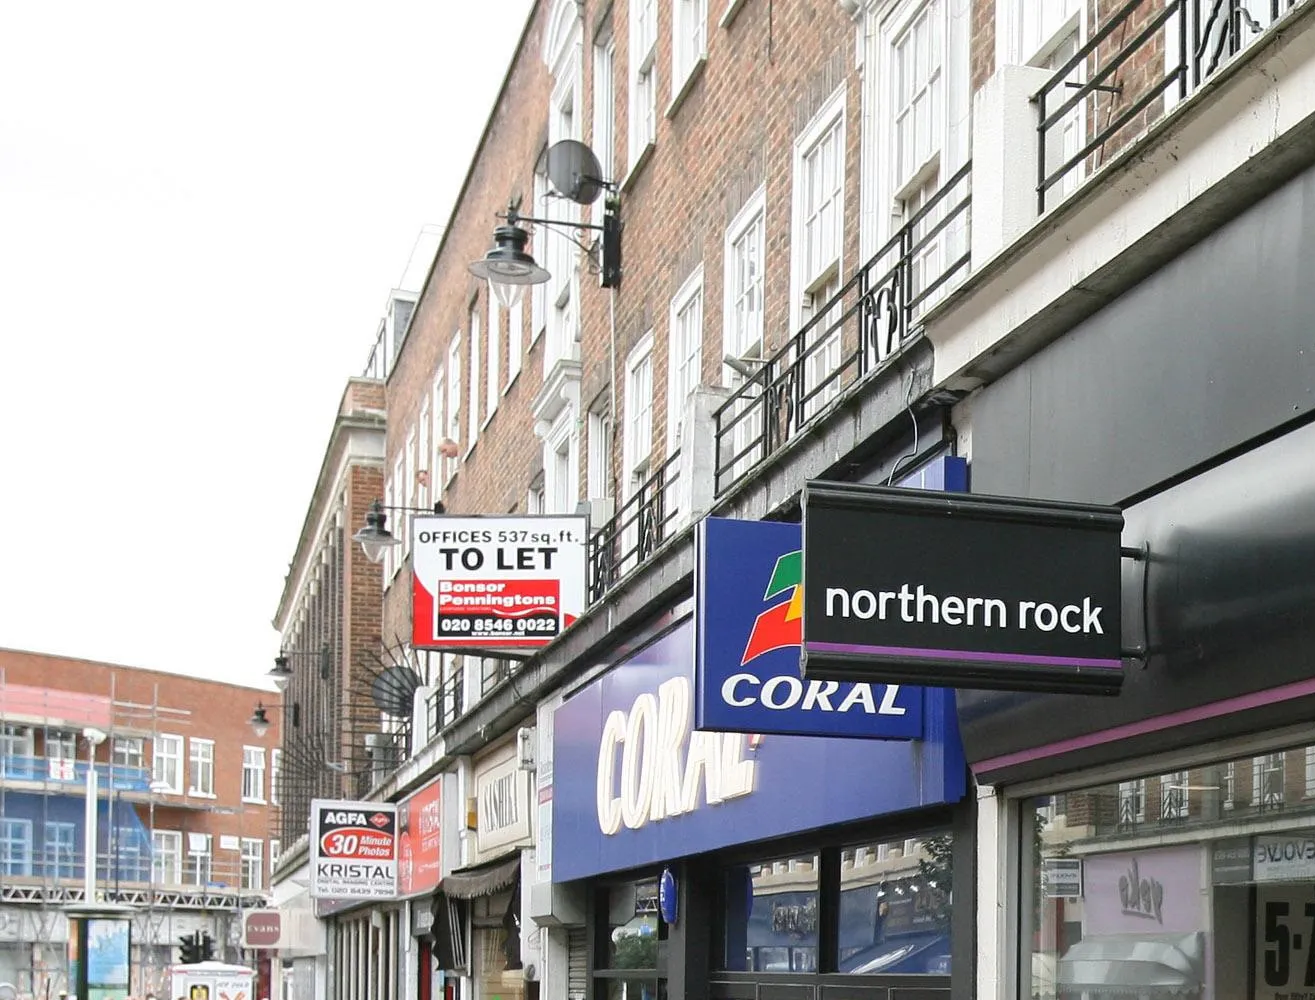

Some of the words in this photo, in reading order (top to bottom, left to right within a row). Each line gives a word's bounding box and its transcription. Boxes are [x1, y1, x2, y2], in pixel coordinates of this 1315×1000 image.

[419, 531, 492, 543] OFFICES
[439, 548, 484, 571] TO
[497, 547, 558, 570] LET
[440, 581, 505, 593] Bonsor
[440, 594, 556, 607] Penningtons
[825, 583, 1007, 629] northern
[1018, 597, 1104, 634] rock
[441, 619, 470, 631] 020
[474, 619, 513, 631] 8546
[518, 619, 556, 631] 0022
[721, 673, 907, 716] CORAL
[596, 675, 760, 836] CORAL
[325, 812, 368, 826] AGFA
[329, 835, 358, 855] 30
[360, 836, 392, 846] Minute
[358, 846, 391, 857] Photos
[318, 864, 394, 879] KRISTAL
